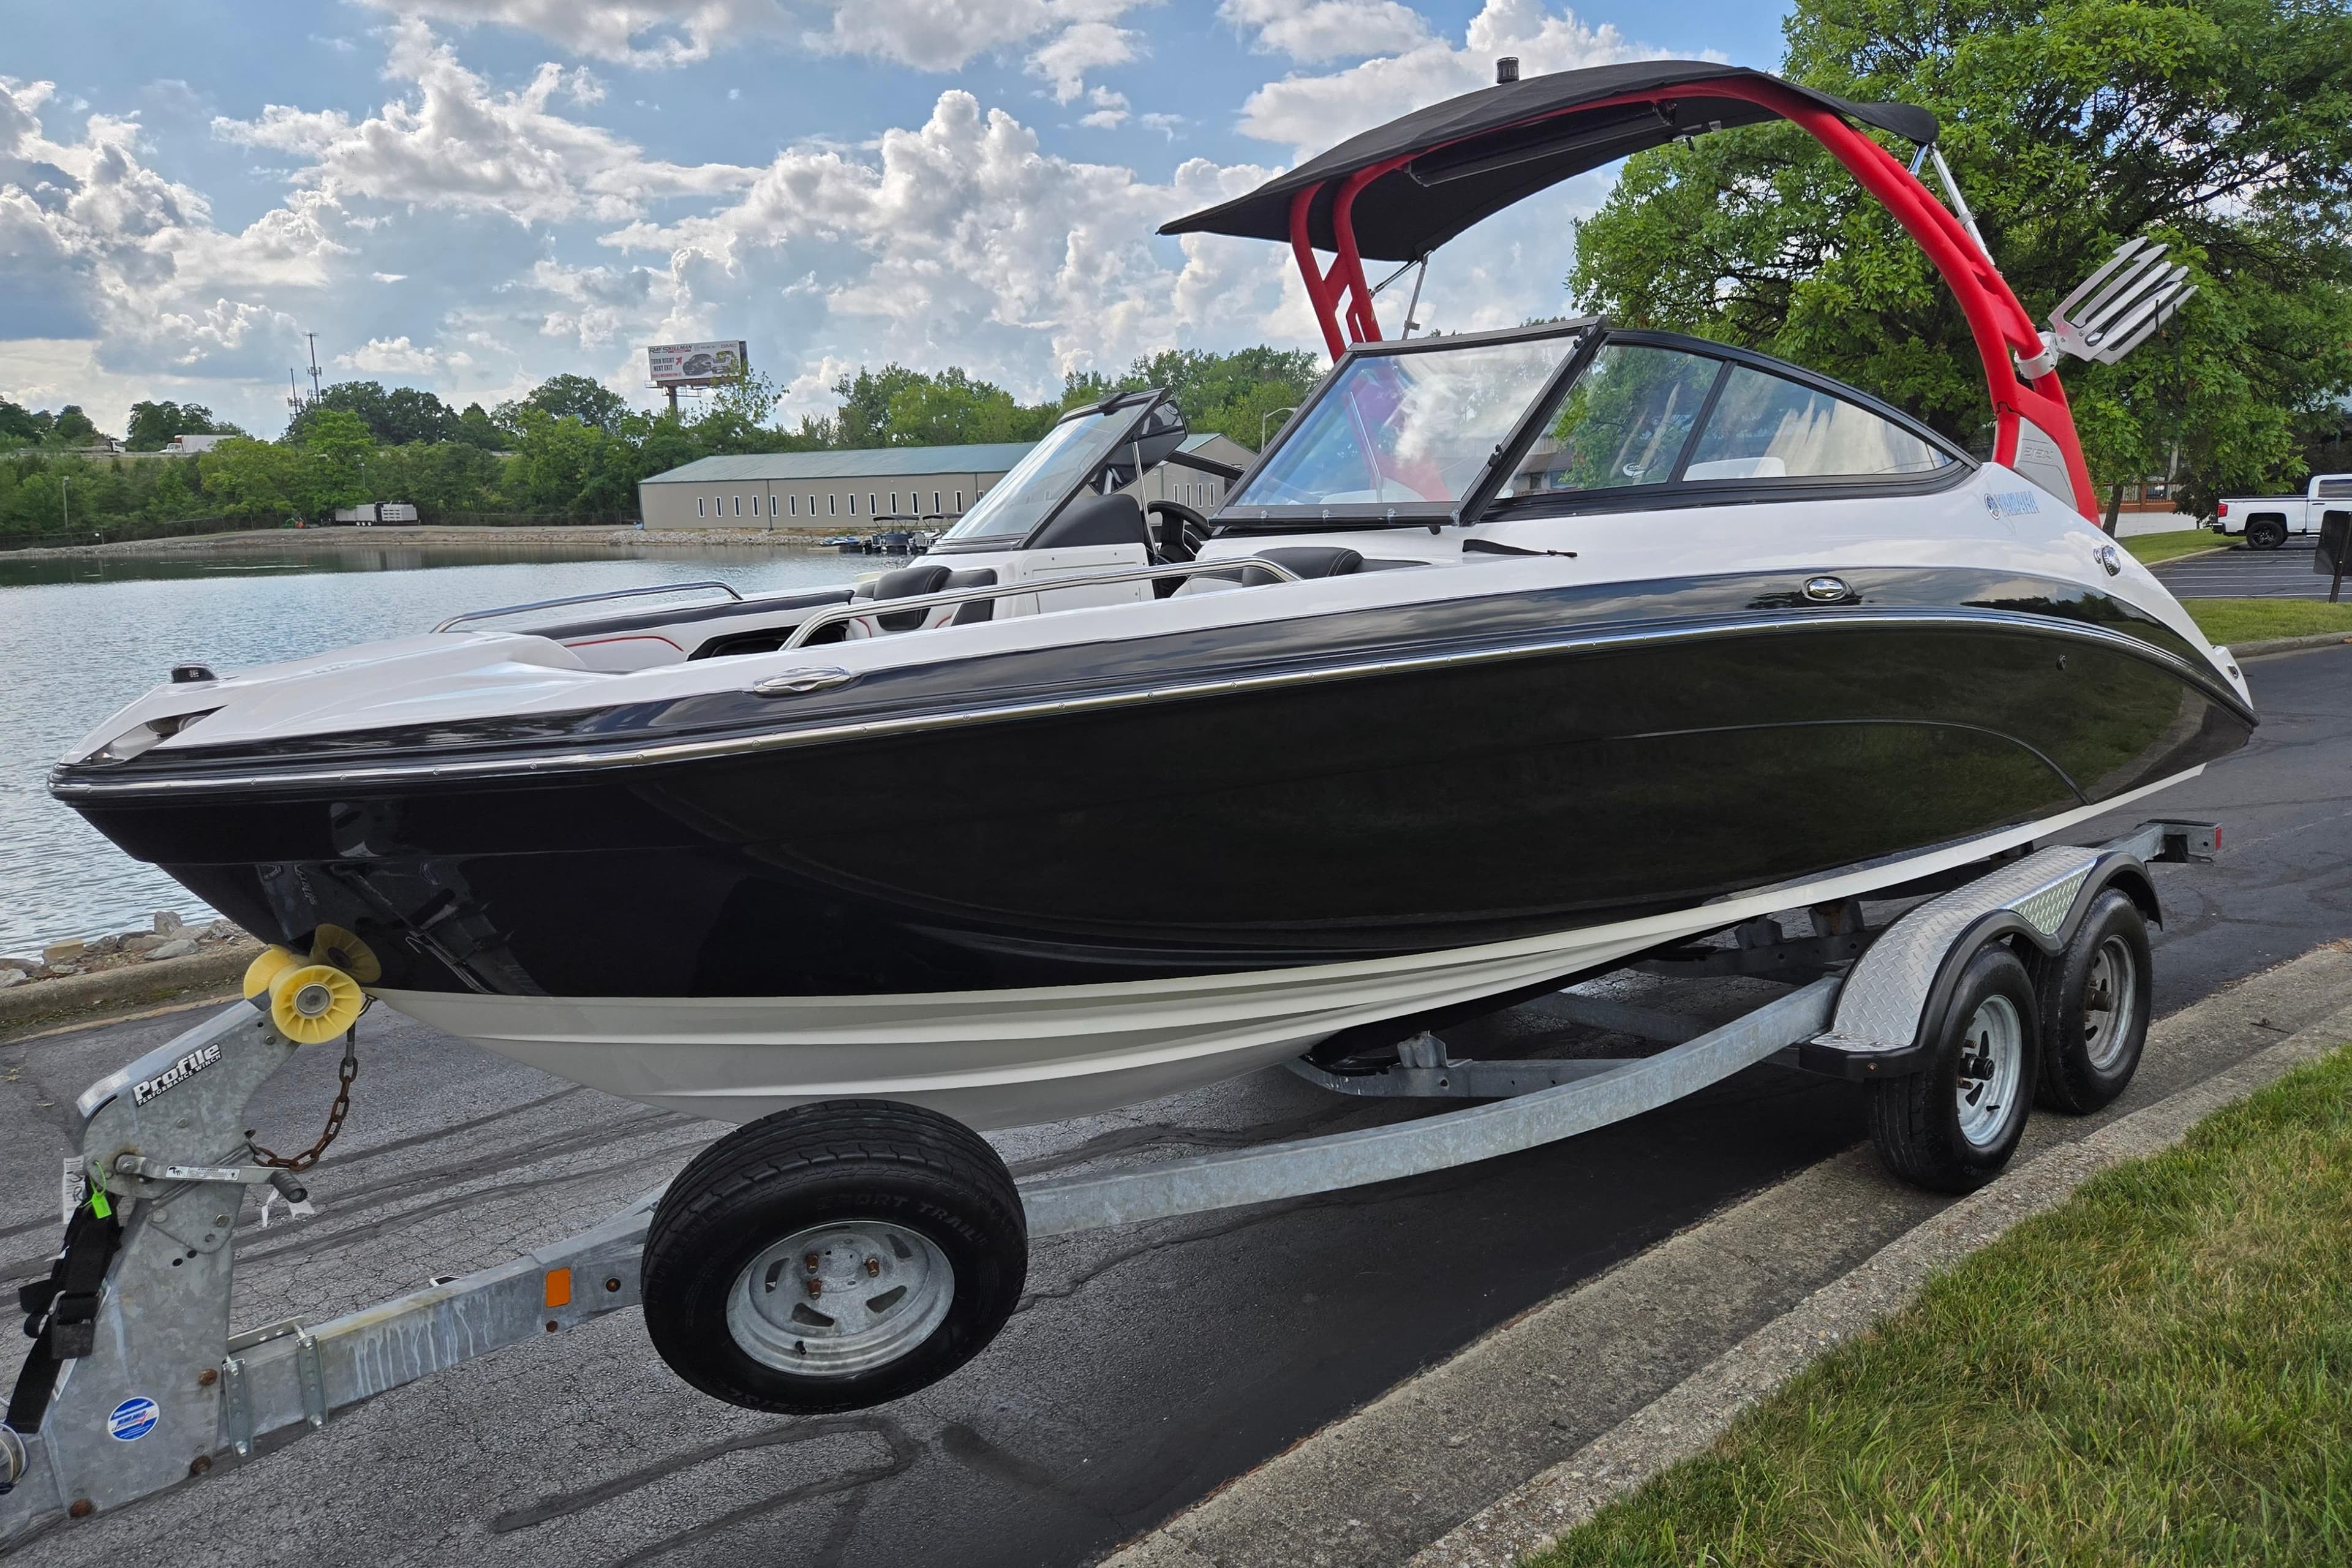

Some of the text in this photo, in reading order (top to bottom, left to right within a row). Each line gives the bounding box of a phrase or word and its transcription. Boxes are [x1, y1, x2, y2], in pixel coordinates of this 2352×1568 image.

[662, 345, 692, 353] SKILLMAN
[132, 1043, 221, 1101] Profile
[138, 1054, 222, 1106] PERFORMANCE WINCH
[918, 1200, 976, 1242] TRAIL
